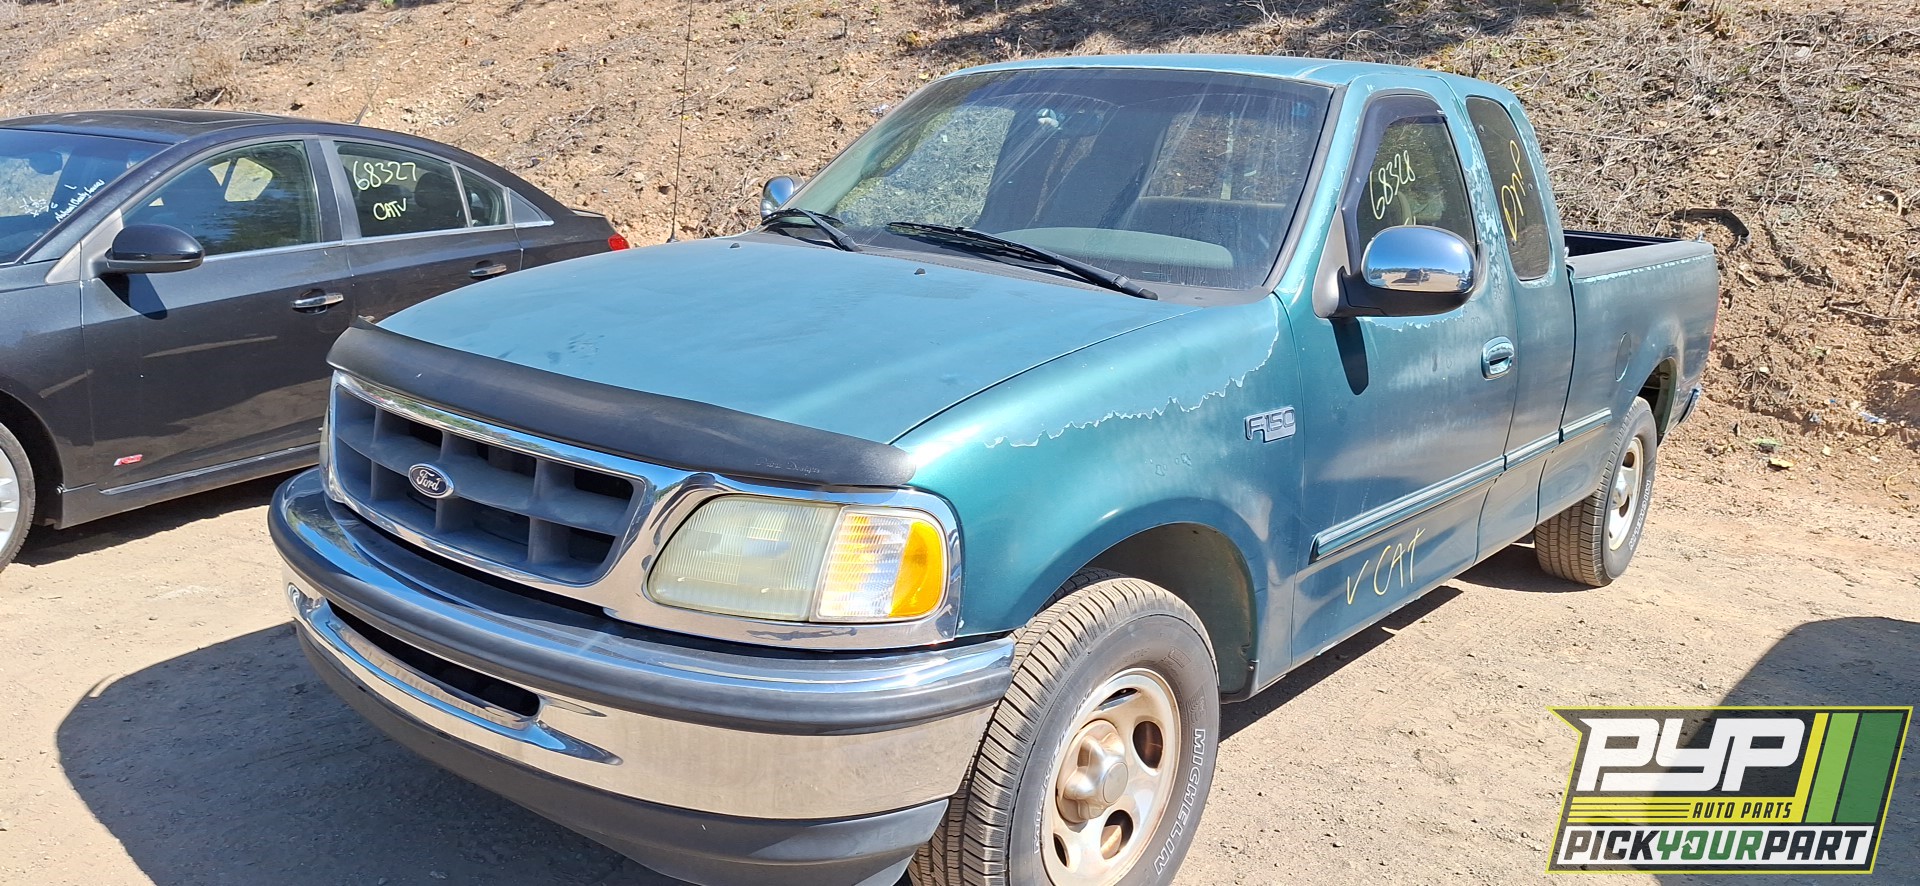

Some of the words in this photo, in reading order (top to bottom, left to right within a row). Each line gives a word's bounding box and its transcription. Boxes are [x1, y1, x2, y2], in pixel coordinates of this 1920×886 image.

[353, 160, 417, 190] 68327
[1369, 150, 1416, 220] 68328
[1247, 409, 1295, 438] F150
[416, 469, 442, 491] Ford
[1373, 527, 1426, 595] CAT
[1153, 728, 1206, 876] MICHELIN
